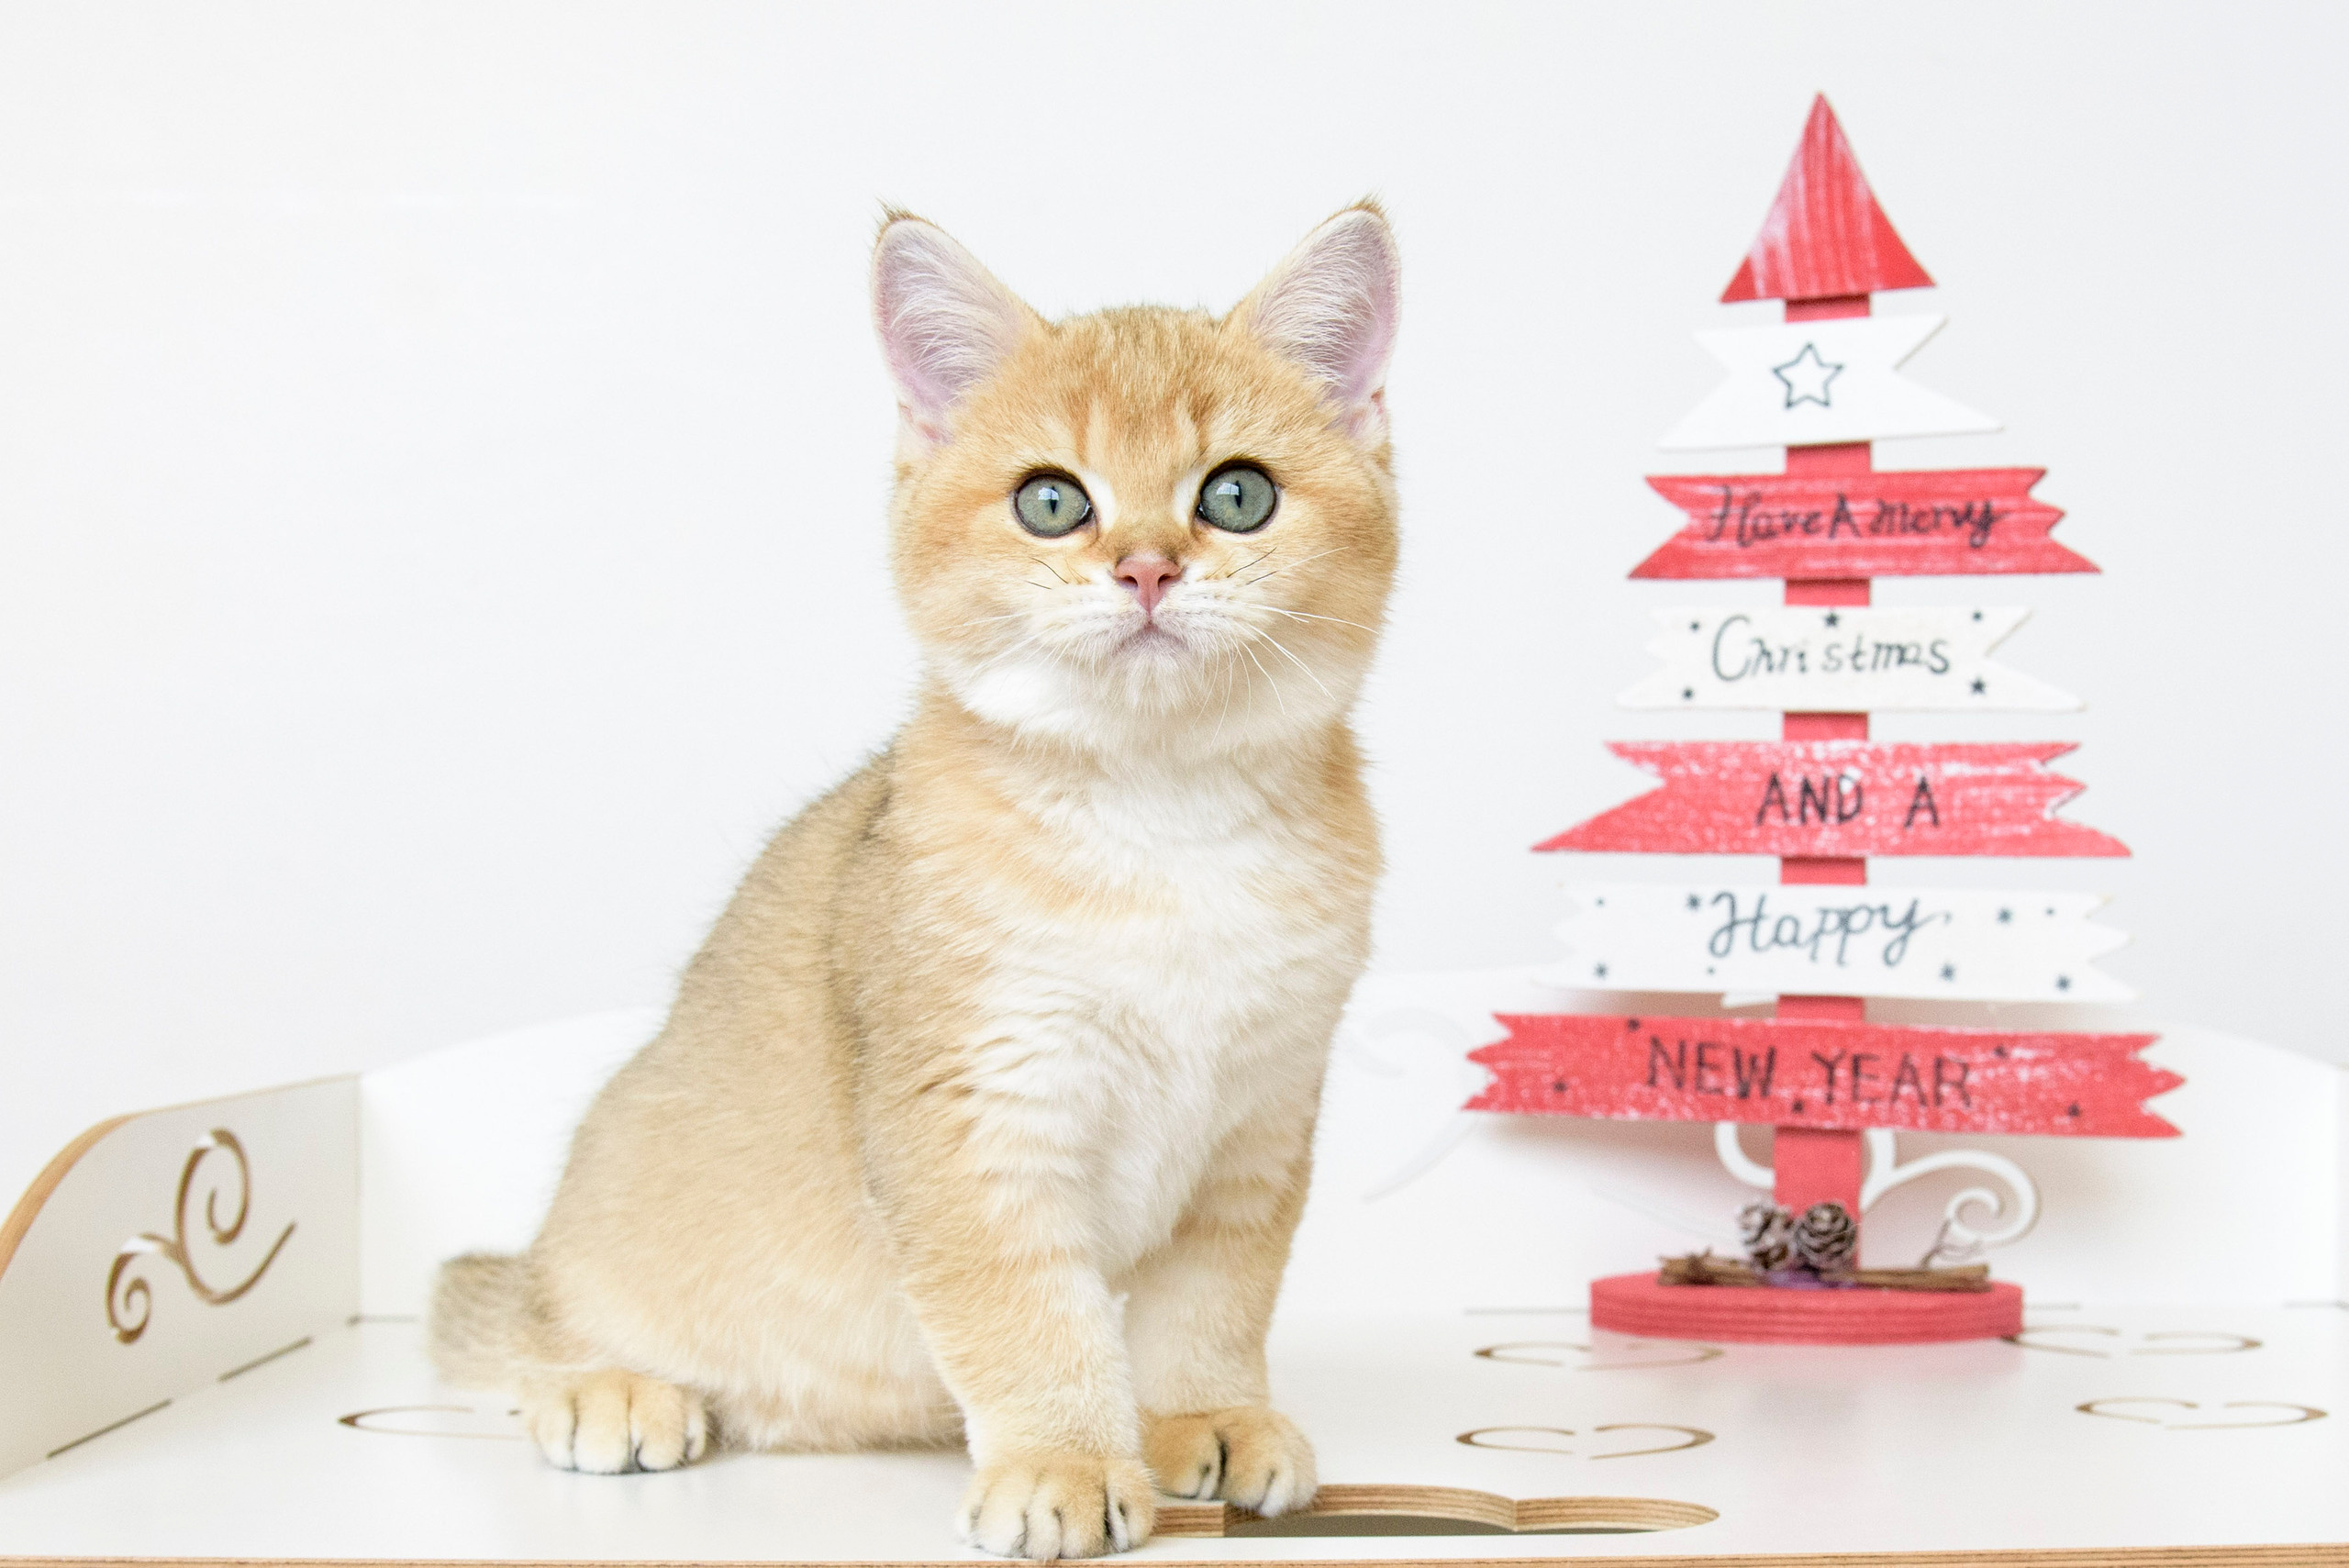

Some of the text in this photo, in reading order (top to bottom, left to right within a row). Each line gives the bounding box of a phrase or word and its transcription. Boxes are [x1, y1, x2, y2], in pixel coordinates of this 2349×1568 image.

[1705, 484, 1824, 548] Have
[1829, 494, 1861, 539] A
[1712, 614, 1951, 682] Christmas
[1755, 773, 1941, 828] AND A
[1647, 1036, 1973, 1108] NEW YEAR
